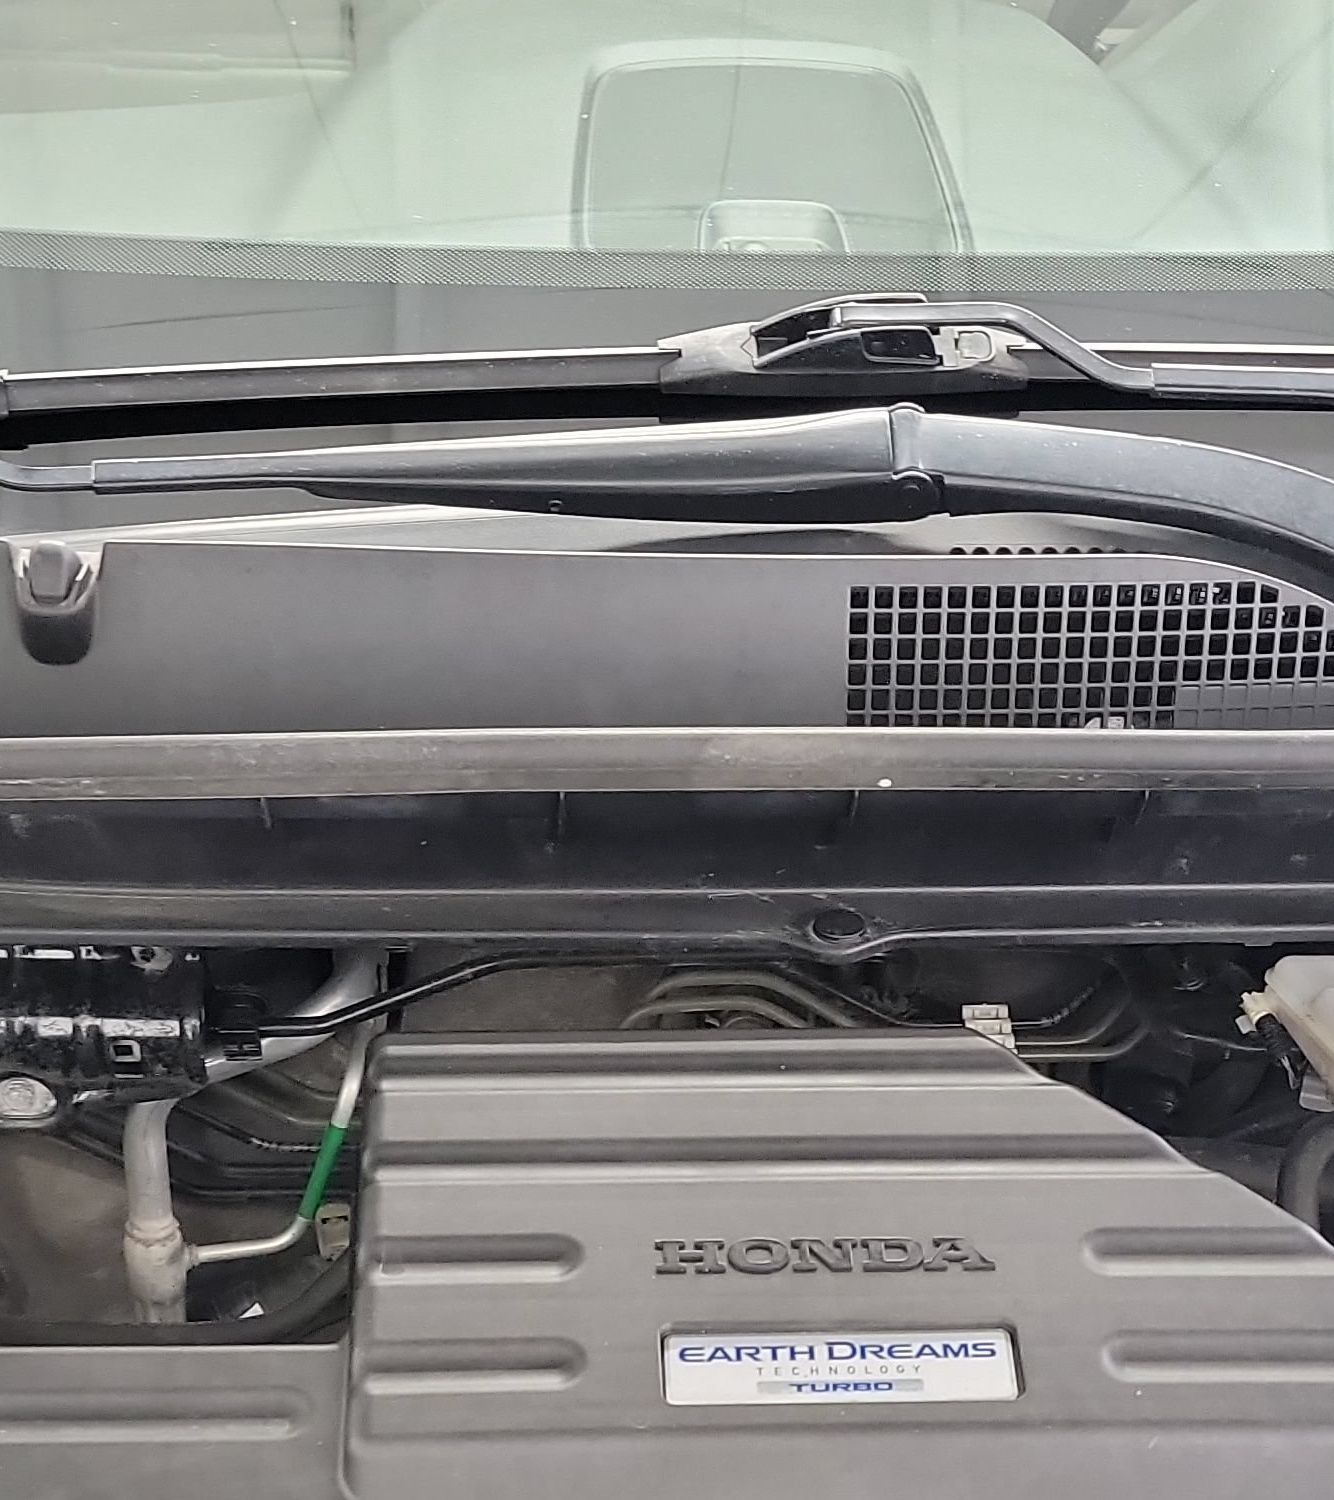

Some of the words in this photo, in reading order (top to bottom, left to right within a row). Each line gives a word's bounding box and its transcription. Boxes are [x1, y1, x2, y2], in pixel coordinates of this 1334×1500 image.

[654, 1236, 996, 1275] HONDA
[678, 1345, 816, 1363] EARTH
[827, 1341, 997, 1361] DREAMS
[756, 1363, 923, 1376] TECHNOLOGY
[789, 1381, 893, 1393] TURBO
